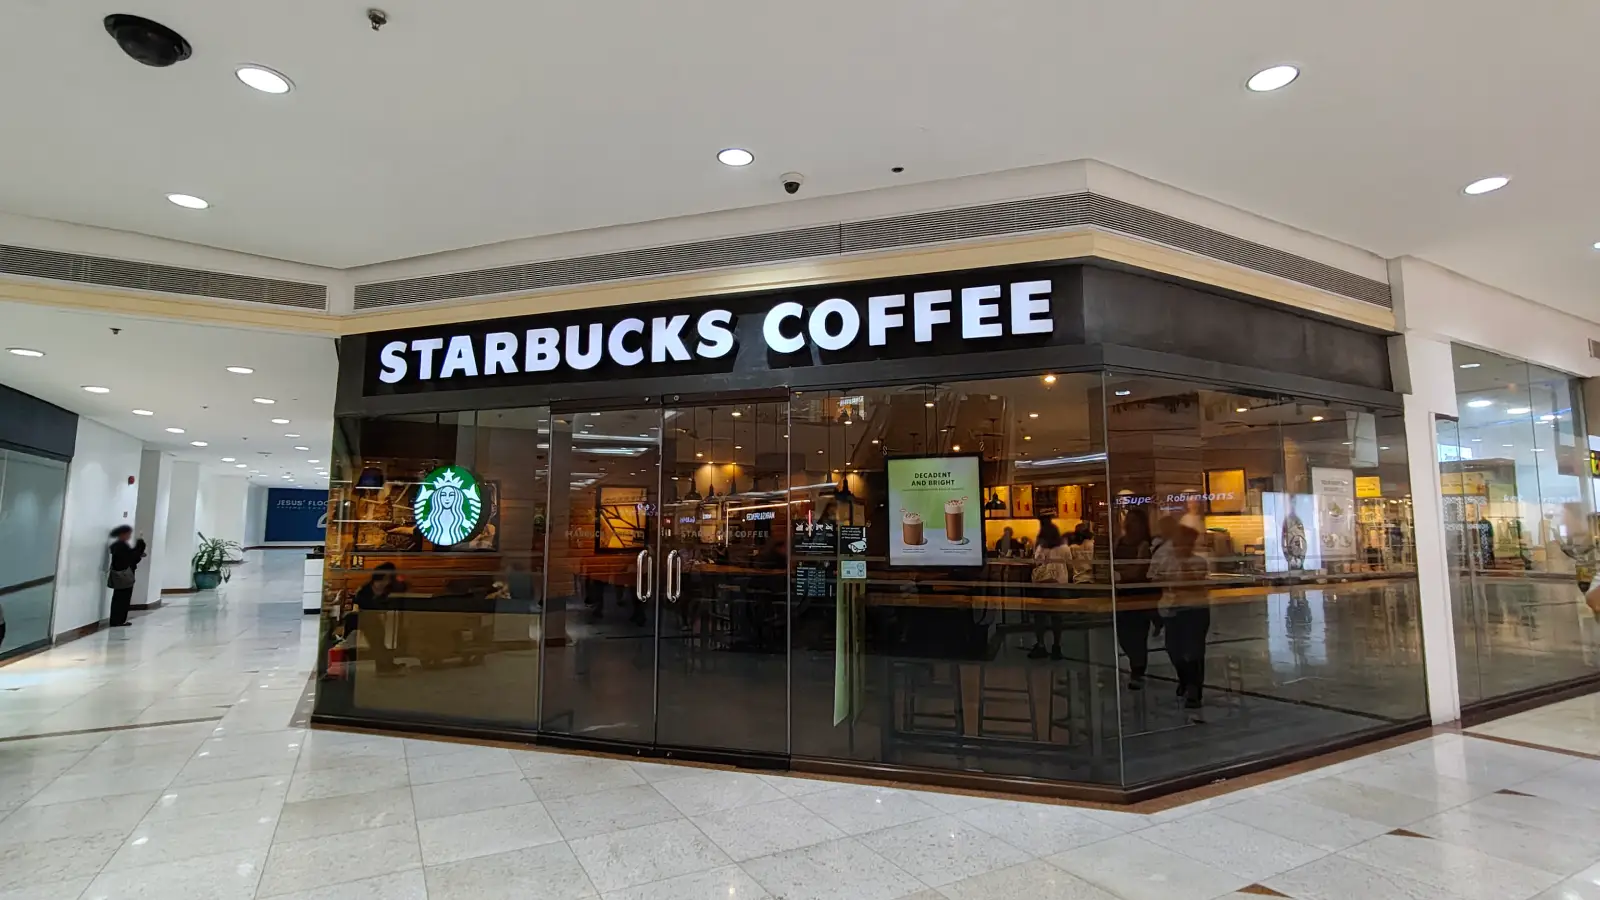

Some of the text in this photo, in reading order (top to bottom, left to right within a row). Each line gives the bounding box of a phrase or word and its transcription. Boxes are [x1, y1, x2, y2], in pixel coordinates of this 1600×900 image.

[378, 279, 1054, 384] STARBUCKS COFFEE
[914, 471, 951, 479] DECADENT
[734, 530, 769, 538] COFFEE
